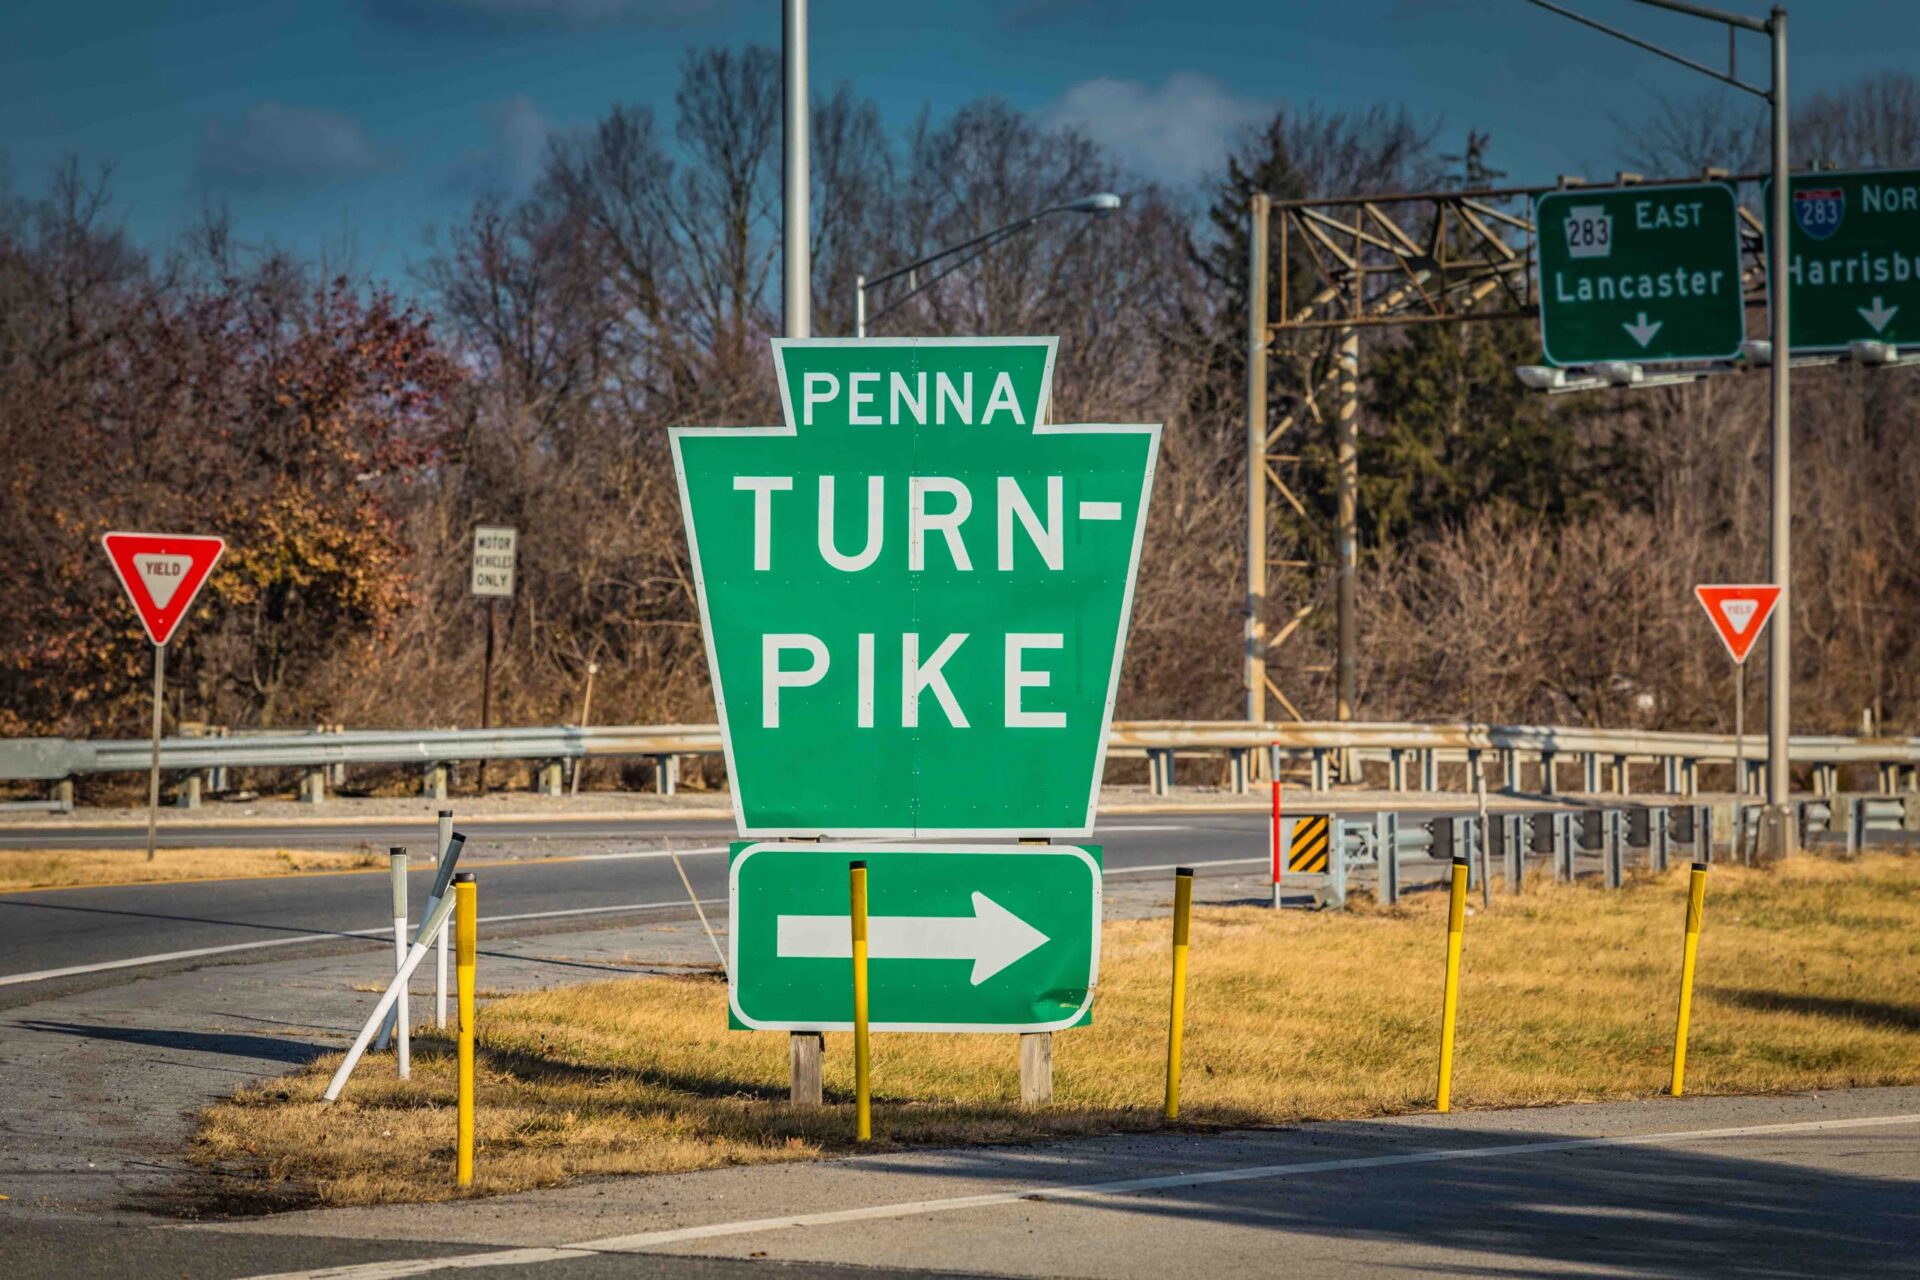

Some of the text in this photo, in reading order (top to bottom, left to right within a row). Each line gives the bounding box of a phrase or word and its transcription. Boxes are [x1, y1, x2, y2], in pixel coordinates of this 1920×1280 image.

[1862, 185, 1920, 212] NOR
[1636, 202, 1703, 230] EAST
[1802, 201, 1838, 225] 283
[1569, 219, 1608, 247] 283
[1788, 251, 1920, 286] Harrisb
[1556, 268, 1723, 302] Lancaster
[803, 371, 1026, 426] PENNA
[733, 475, 1122, 572] TURN-
[479, 536, 511, 549] MOTOR
[146, 562, 181, 575] YIELD
[477, 573, 507, 587] ONLY
[762, 633, 1067, 728] PIKE
